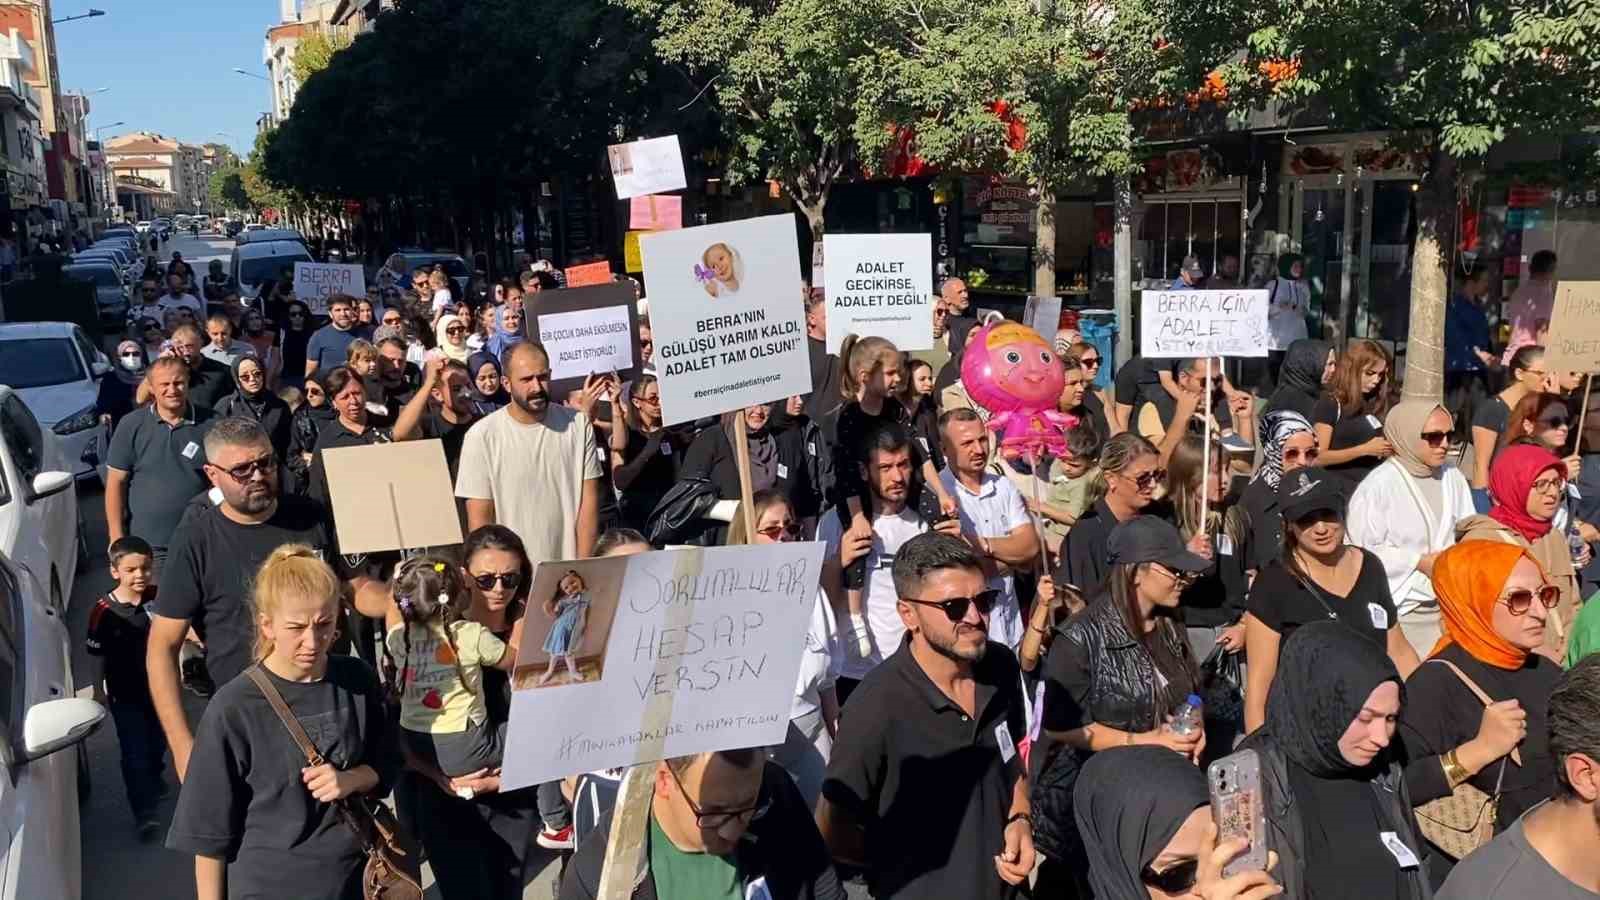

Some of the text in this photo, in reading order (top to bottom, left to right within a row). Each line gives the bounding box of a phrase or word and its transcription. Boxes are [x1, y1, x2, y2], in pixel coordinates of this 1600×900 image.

[300, 267, 351, 284] BERRA
[856, 262, 904, 274] ADALET
[846, 276, 915, 291] GECİKİRSE,
[835, 291, 927, 308] ADALET DEĞİL!
[1158, 294, 1212, 313] BERRA
[696, 309, 765, 332] BERRA'NIN
[1160, 317, 1238, 337] ADALET
[553, 327, 574, 342] ÇOCUK
[661, 320, 801, 359] GÜLÜŞÜ YARIM KALDI,
[559, 349, 581, 361] ADALET
[665, 355, 717, 376] ADALET
[720, 349, 746, 365] TAM
[633, 611, 764, 662] HESAP
